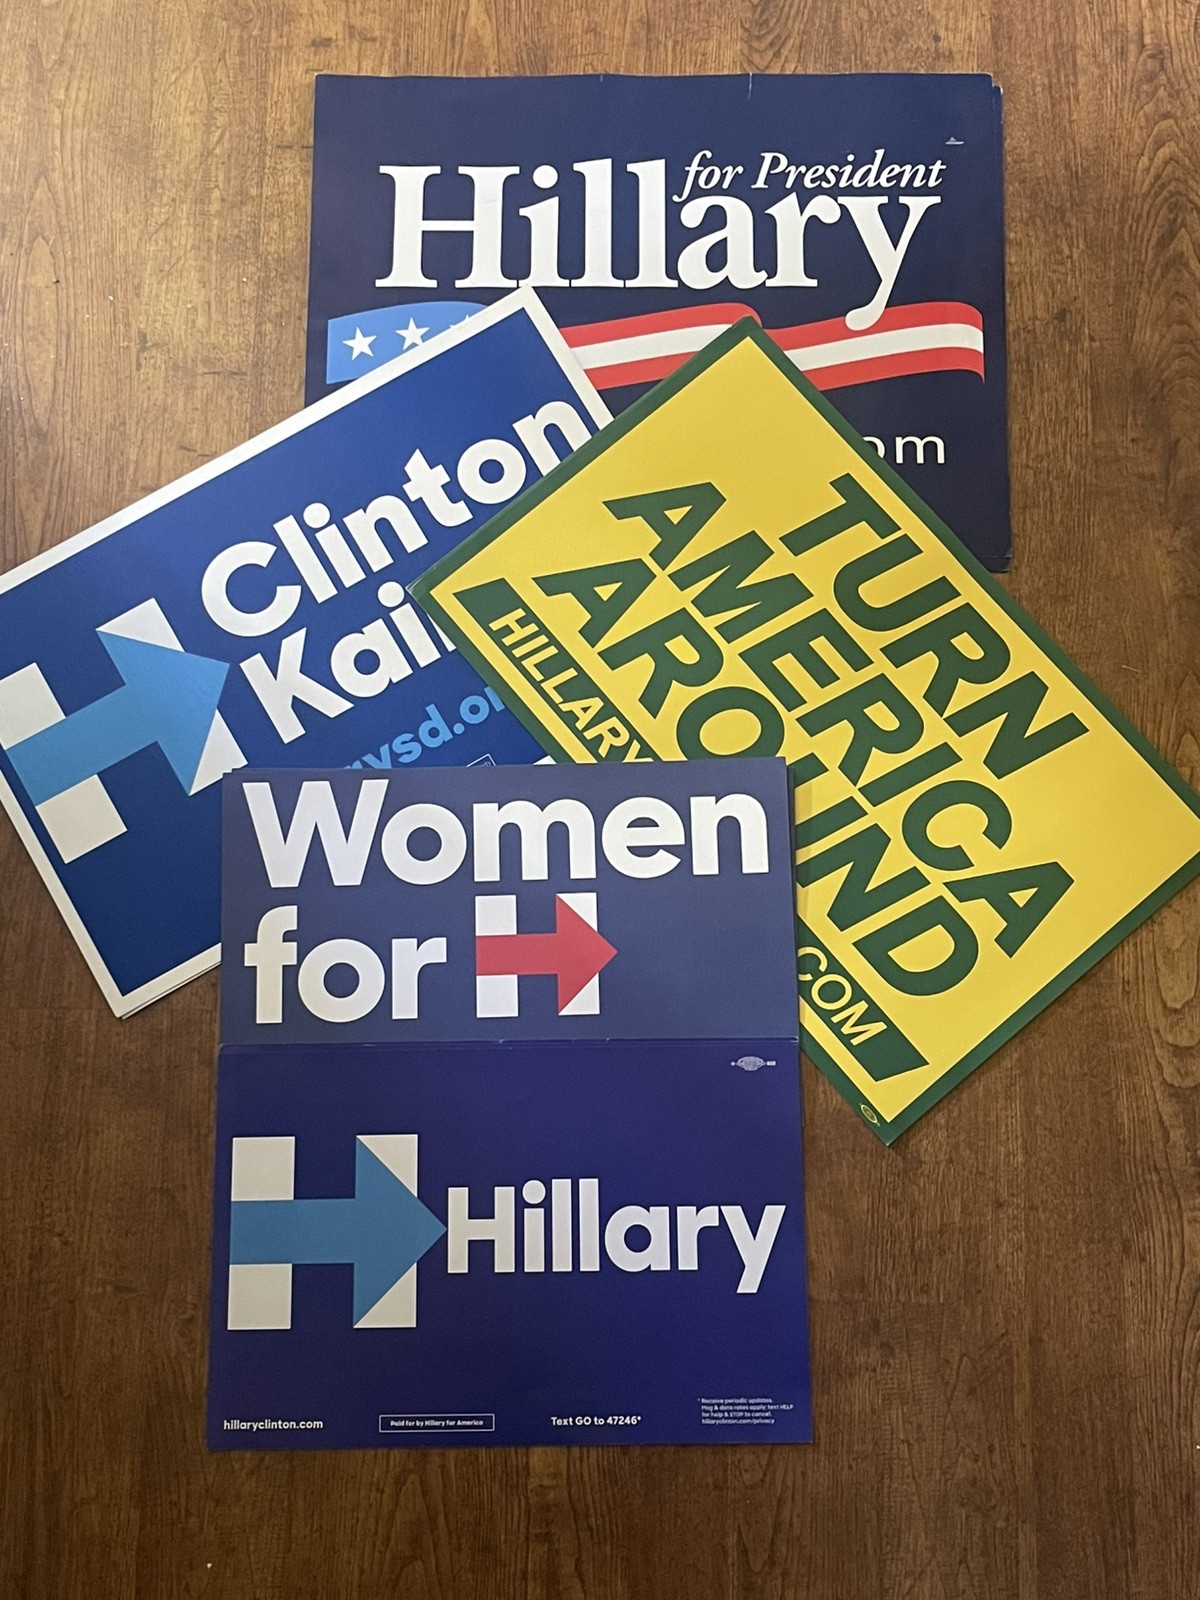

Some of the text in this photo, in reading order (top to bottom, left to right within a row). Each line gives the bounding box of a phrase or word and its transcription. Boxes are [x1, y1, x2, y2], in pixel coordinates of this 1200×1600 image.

[672, 148, 947, 203] for President
[375, 157, 942, 331] Hillary
[201, 400, 592, 637] Clinton
[239, 581, 457, 745] Kai
[778, 472, 1090, 780] TURN
[344, 686, 505, 769] ysd.o
[602, 481, 1075, 958] AMERICA
[242, 778, 769, 888] Women
[244, 905, 447, 1024] for
[447, 1178, 786, 1294] Hillary
[223, 1419, 324, 1431] hillaryclinton.com
[551, 1416, 574, 1426] Text
[575, 1416, 592, 1426] GO
[593, 1416, 605, 1425] to
